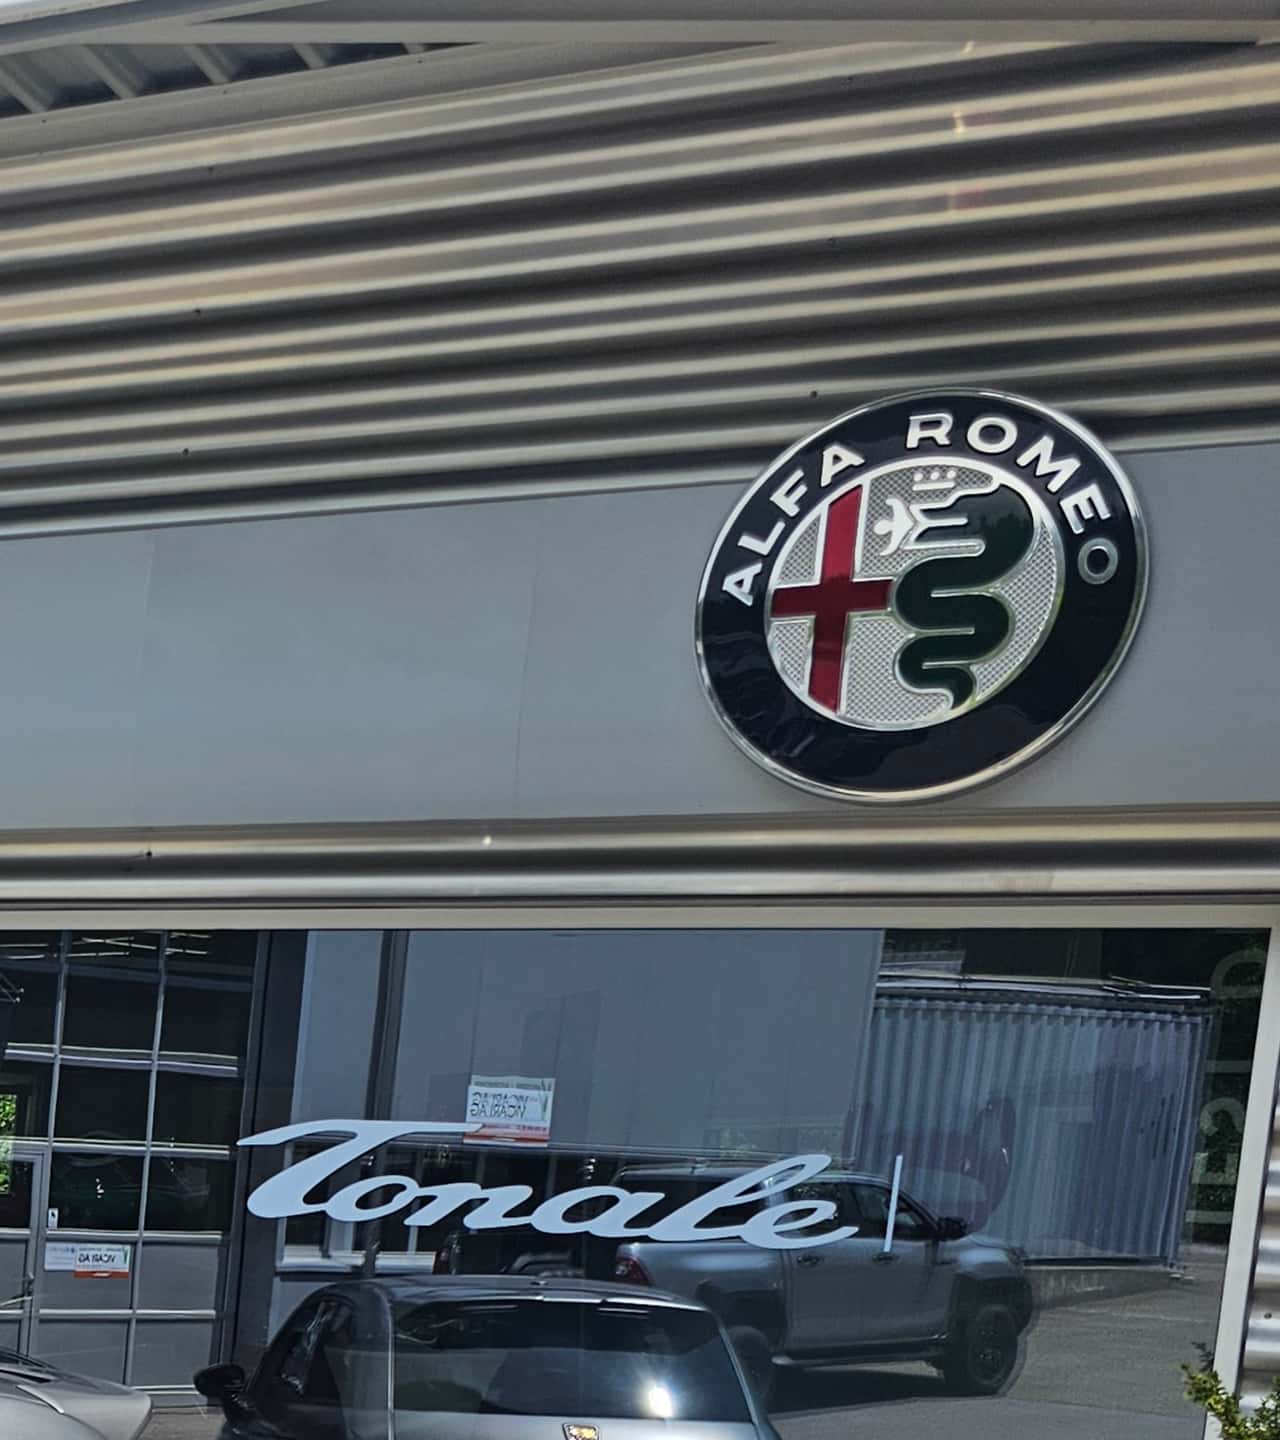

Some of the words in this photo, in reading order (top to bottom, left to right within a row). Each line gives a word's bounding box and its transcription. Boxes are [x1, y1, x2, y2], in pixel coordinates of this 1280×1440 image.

[722, 444, 866, 606] ALFA
[906, 412, 1119, 585] ROMEO
[236, 1118, 859, 1250] Tonale
